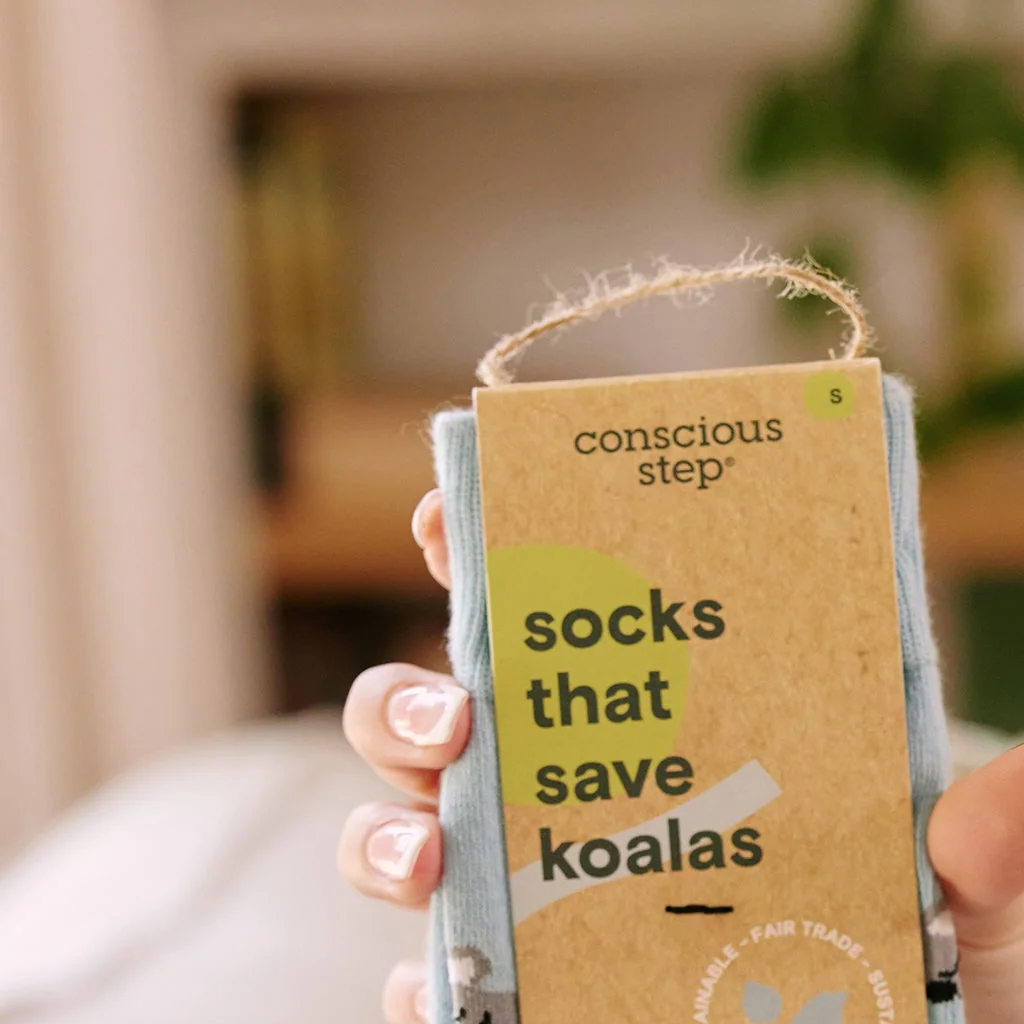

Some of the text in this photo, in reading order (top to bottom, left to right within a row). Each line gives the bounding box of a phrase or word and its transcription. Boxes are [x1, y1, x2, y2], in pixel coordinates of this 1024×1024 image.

[574, 417, 783, 454] conscious
[524, 588, 725, 651] socks
[527, 671, 671, 727] that
[536, 755, 694, 805] save
[540, 818, 763, 881] koalas
[750, 920, 796, 944] FAIR
[802, 921, 863, 959] TRADE
